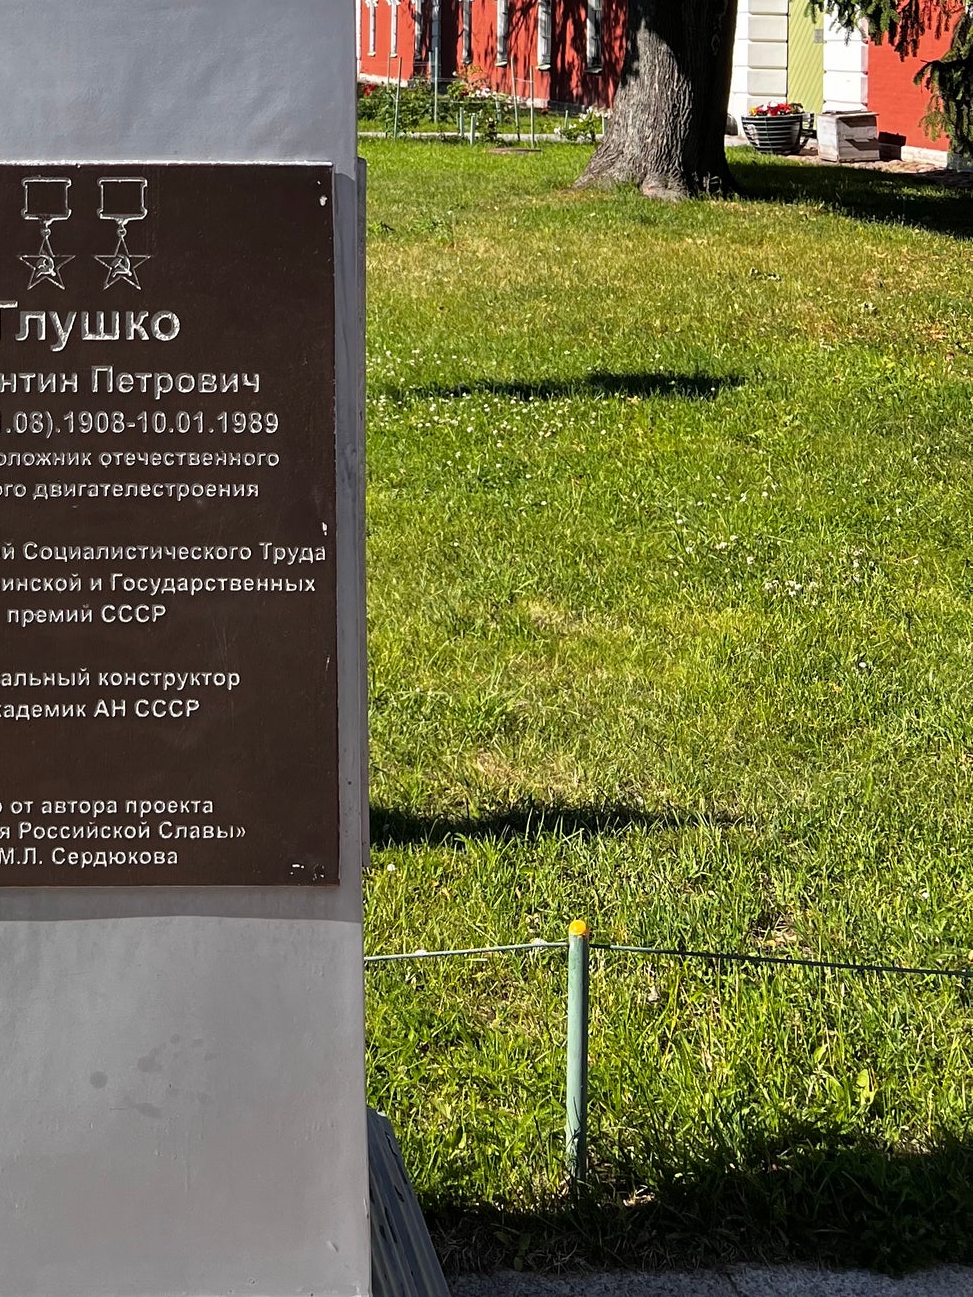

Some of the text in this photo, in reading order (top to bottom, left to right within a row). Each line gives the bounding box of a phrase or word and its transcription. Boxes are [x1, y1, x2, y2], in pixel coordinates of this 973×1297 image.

[91, 365, 260, 401] Петрович
[98, 450, 280, 469] отечественного
[32, 482, 259, 503] двигателестроения
[22, 541, 252, 563] Социалистического
[258, 541, 326, 566] Труда
[89, 577, 103, 592] и
[110, 572, 316, 597] Государственных
[7, 603, 167, 628] премий СССР
[98, 671, 241, 691] конструктор
[93, 698, 126, 718] АН
[134, 698, 200, 718] СССР
[10, 800, 34, 815] от
[41, 799, 118, 819] автора
[125, 799, 214, 818] проекта
[18, 820, 150, 840] Российской
[158, 820, 246, 840] Славы»
[51, 846, 178, 869] Сердюкова
